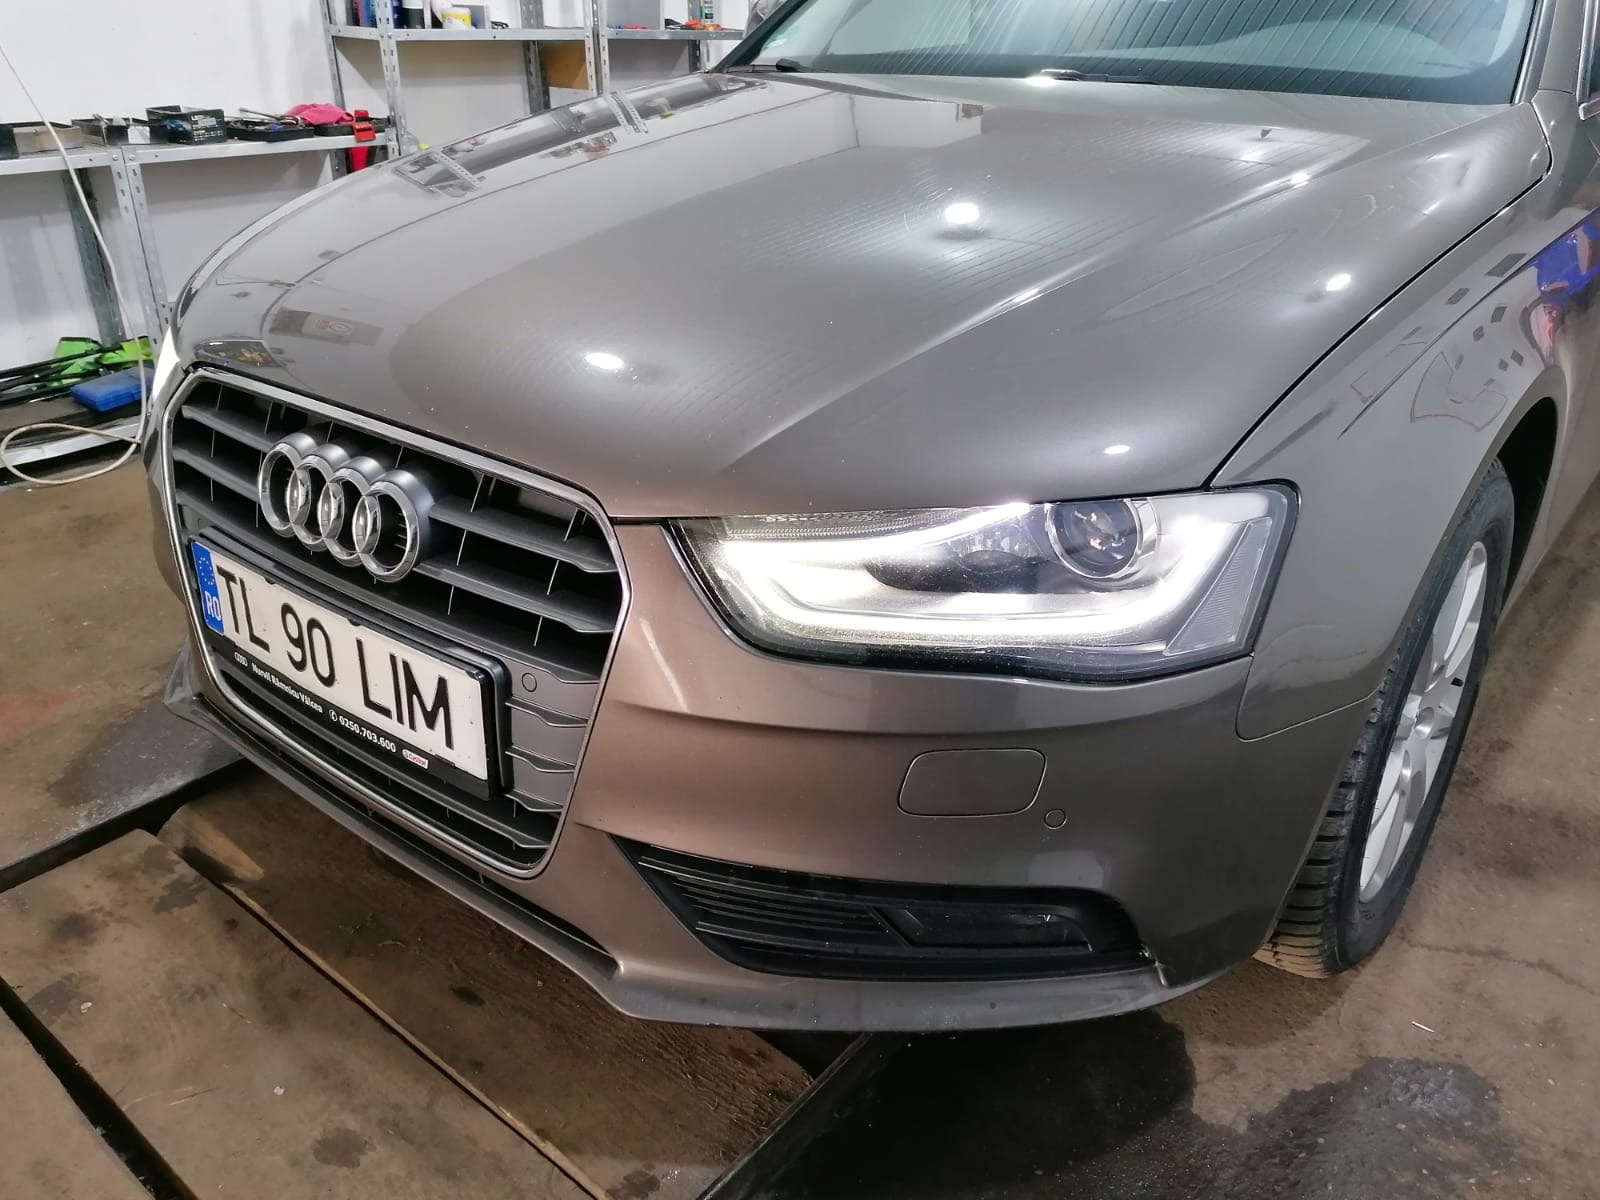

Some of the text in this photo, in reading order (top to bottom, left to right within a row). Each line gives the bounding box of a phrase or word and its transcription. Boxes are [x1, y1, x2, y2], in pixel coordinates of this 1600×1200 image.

[205, 590, 222, 621] RO
[215, 564, 455, 751] TL 90 LIM
[339, 715, 396, 753] 0250.703.600
